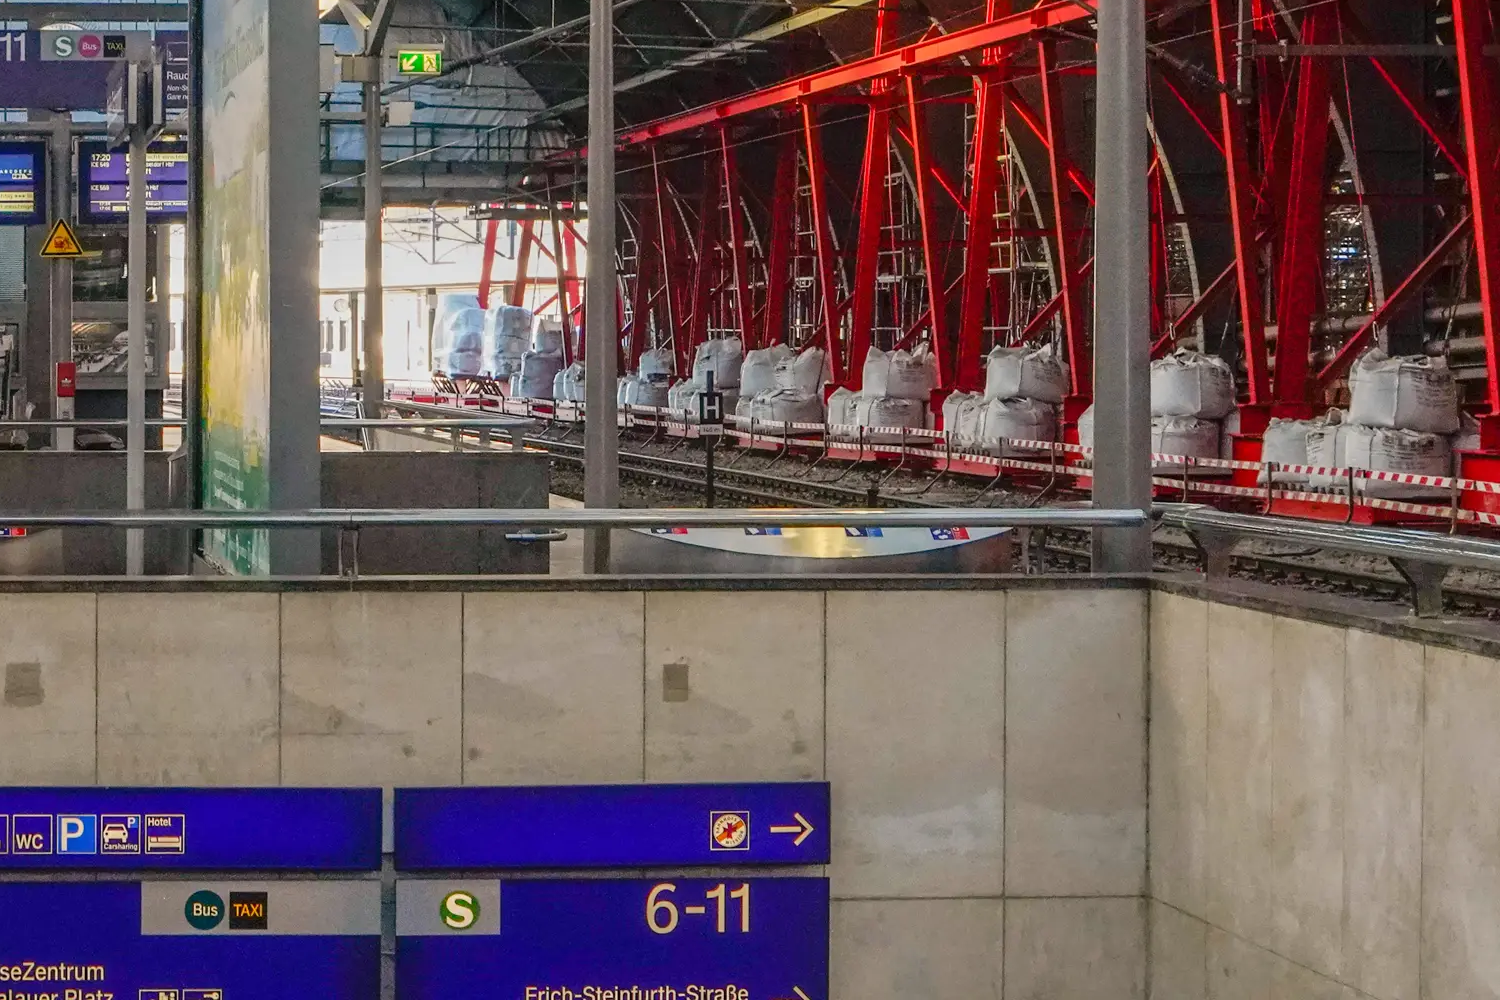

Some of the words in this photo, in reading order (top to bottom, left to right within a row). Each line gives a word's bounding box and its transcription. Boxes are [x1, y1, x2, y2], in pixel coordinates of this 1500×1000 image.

[55, 36, 73, 57] S
[82, 42, 97, 51] Bus
[106, 42, 124, 50] TAXI
[703, 396, 720, 419] H
[127, 817, 136, 828] P
[148, 817, 172, 827] Hotel
[16, 833, 43, 849] WC
[60, 817, 84, 851] P
[103, 842, 138, 851] Carsharing
[193, 902, 219, 917] Bus
[233, 903, 263, 917] TAXI
[445, 893, 475, 928] S
[645, 882, 751, 933] 6-11
[525, 984, 749, 1000] Erich-Steinfurth-Straße
